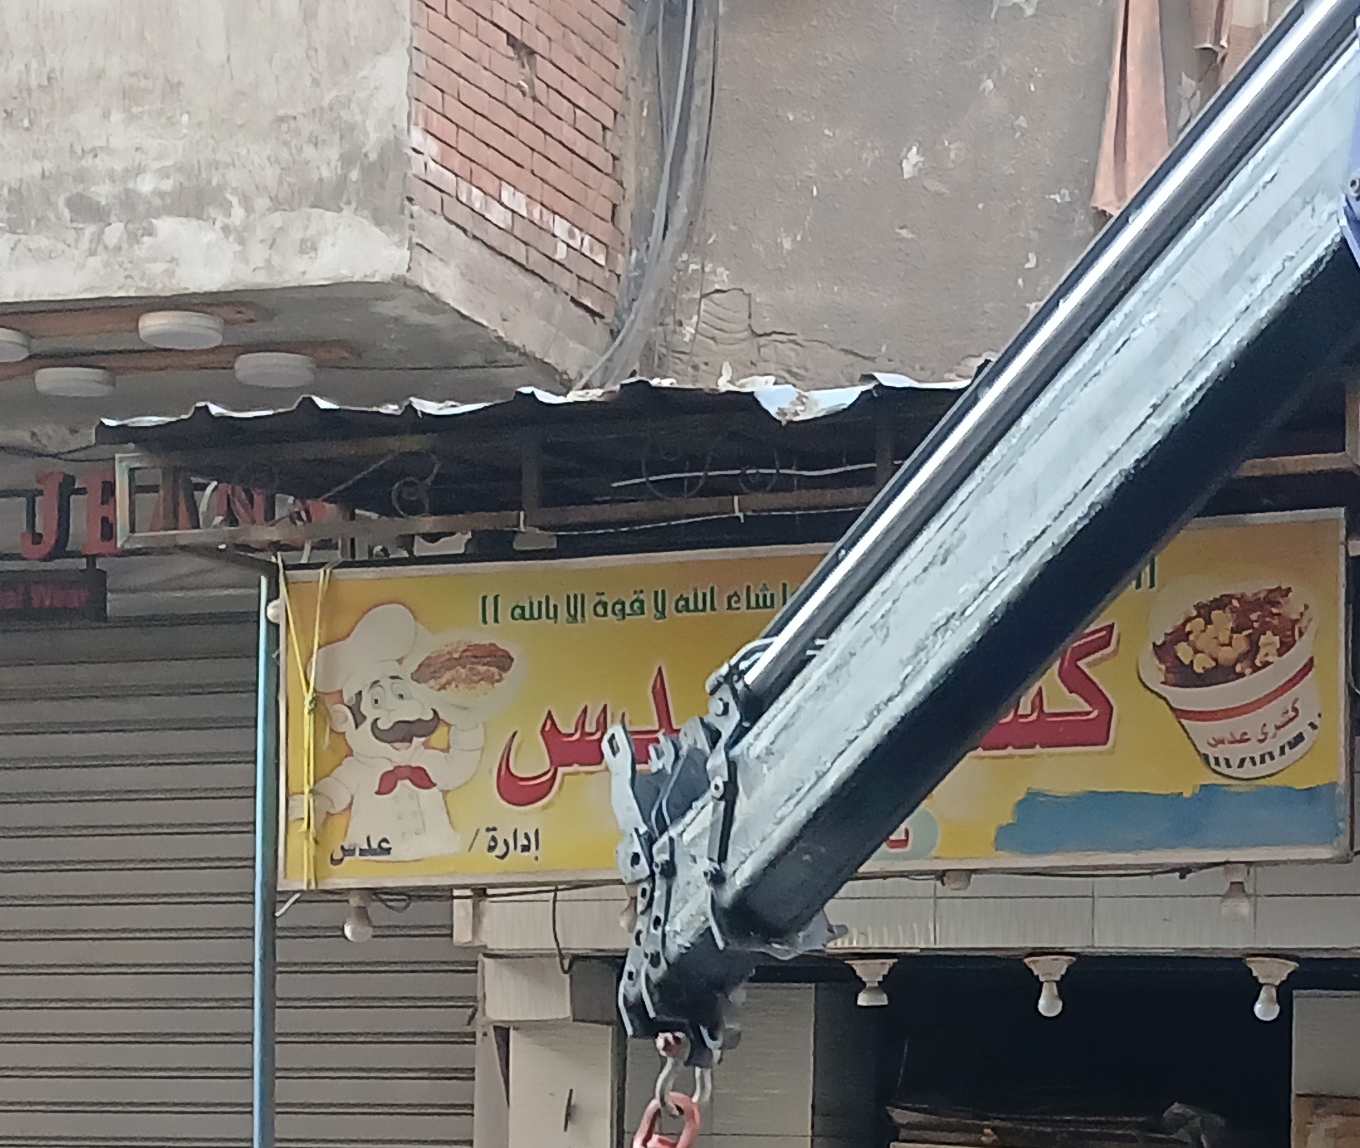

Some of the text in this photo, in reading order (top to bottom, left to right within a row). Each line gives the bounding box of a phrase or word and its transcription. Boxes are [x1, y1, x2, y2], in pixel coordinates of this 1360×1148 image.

[510, 594, 559, 623] بالله
[592, 589, 646, 622] قوة
[652, 589, 668, 621] لا
[674, 586, 717, 614] الله
[726, 583, 776, 612] شاء
[329, 834, 392, 867] عدس
[486, 825, 540, 862] إدارة
